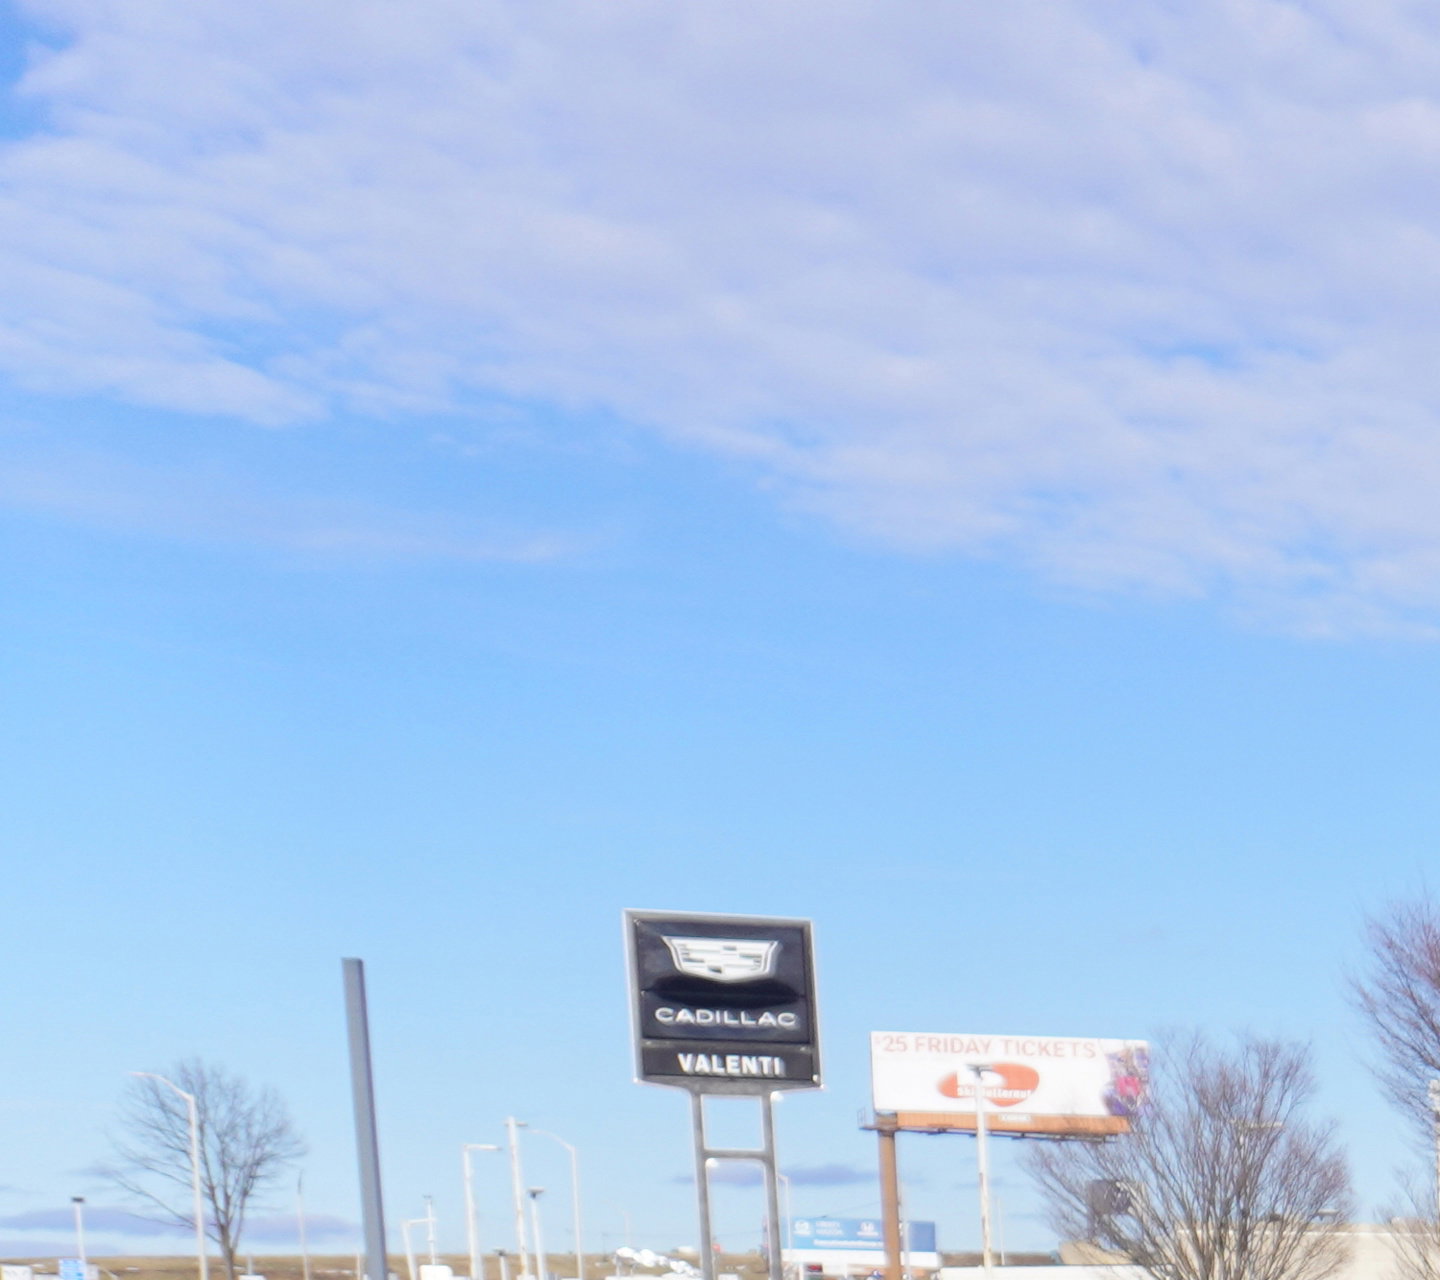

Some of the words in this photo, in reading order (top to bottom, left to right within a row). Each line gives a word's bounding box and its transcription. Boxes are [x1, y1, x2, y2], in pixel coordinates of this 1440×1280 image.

[655, 1007, 797, 1027] CADILLAC
[914, 1036, 991, 1055] FRIDAY
[1000, 1038, 1096, 1059] TICKETS
[677, 1053, 784, 1076] VALENTI
